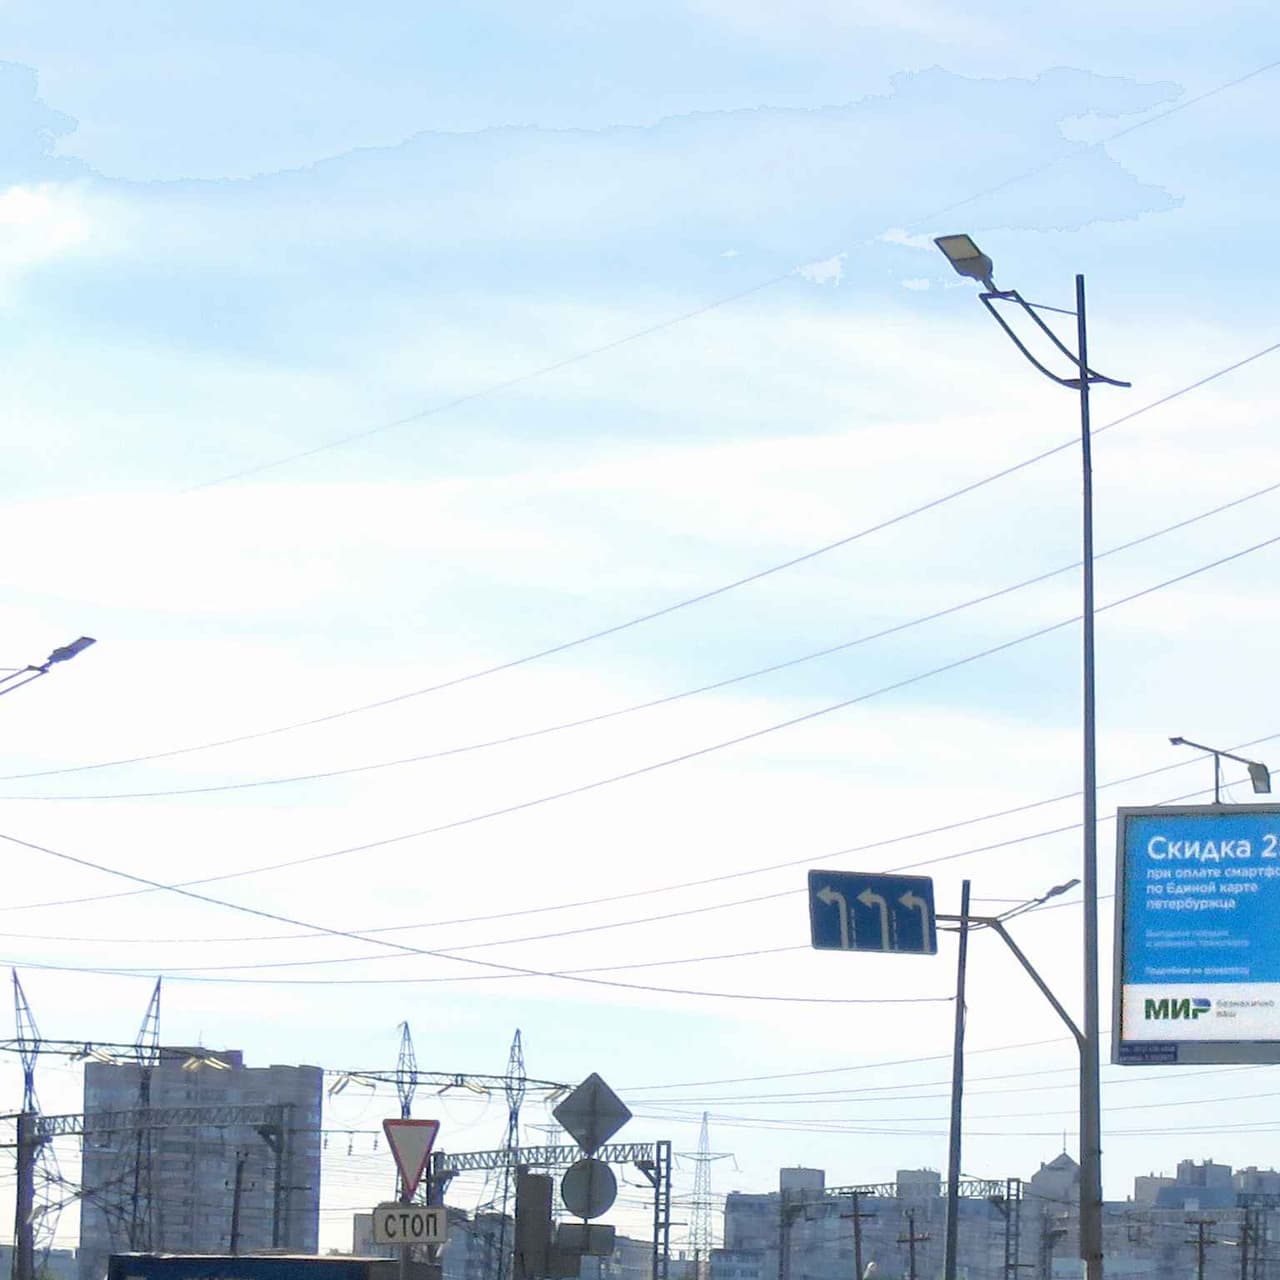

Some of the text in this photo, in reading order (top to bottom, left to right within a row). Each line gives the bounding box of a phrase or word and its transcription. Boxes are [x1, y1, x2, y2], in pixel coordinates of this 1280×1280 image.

[1147, 835, 1252, 862] Скидка
[1146, 868, 1172, 880] при
[1175, 867, 1222, 879] оплате
[1146, 881, 1259, 895] по Единой карте
[1146, 897, 1236, 912] петербуржца
[1144, 998, 1212, 1020] МИР
[384, 1213, 438, 1239] СТОП
